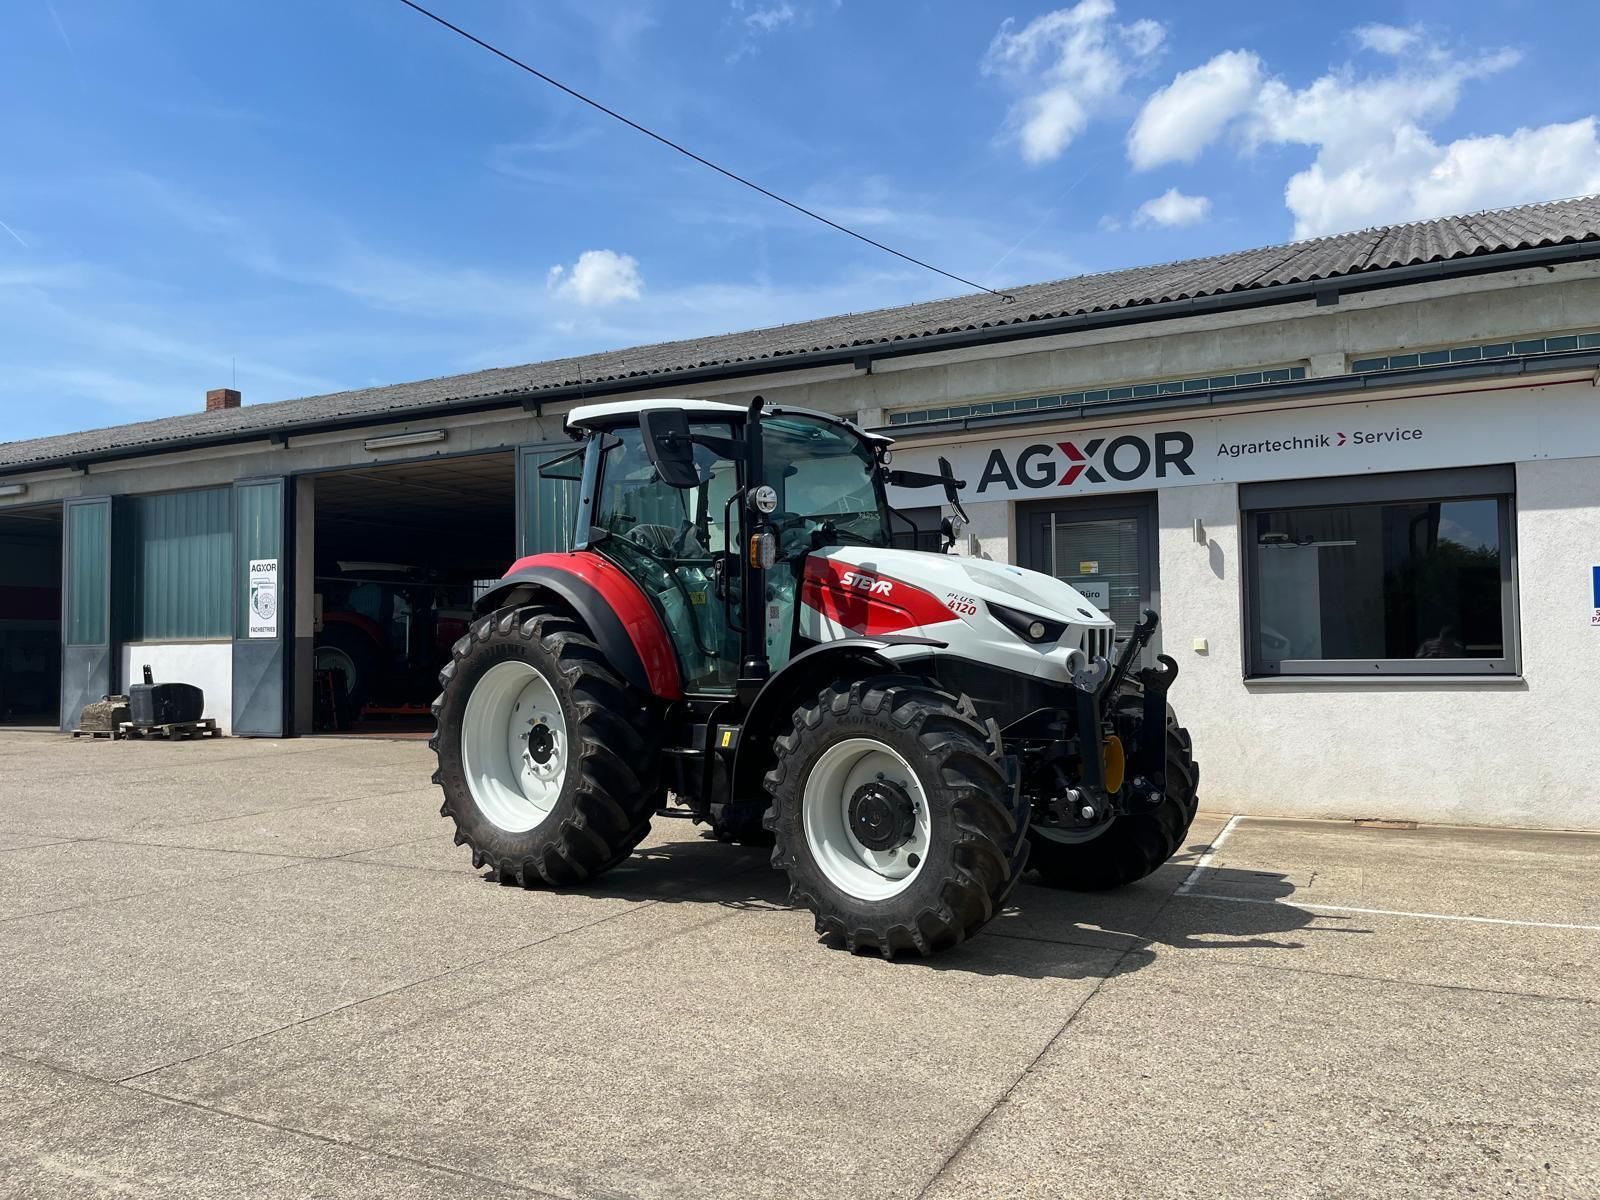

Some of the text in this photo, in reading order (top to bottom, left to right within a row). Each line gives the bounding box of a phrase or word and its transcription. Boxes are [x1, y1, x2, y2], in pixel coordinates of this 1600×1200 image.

[1217, 428, 1423, 457] Agrartechnik Service
[976, 431, 1195, 493] AGXOR
[251, 564, 276, 572] AGXOR
[840, 572, 893, 596] STEYR
[947, 592, 976, 604] PLUS
[948, 599, 977, 616] 4120
